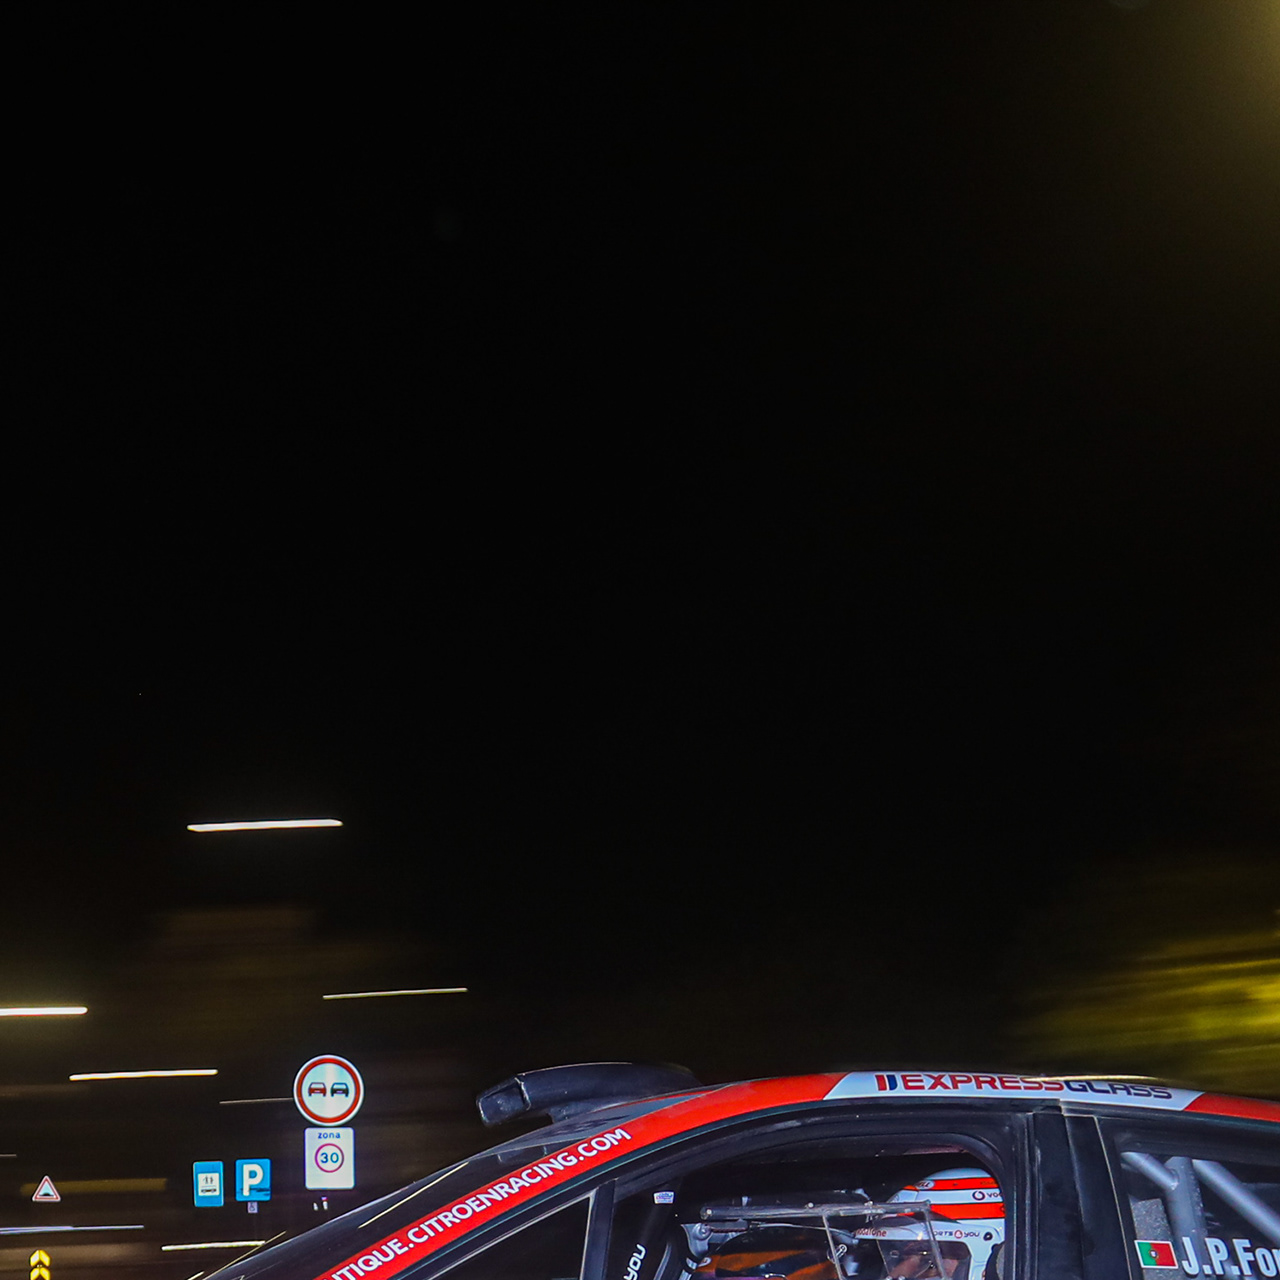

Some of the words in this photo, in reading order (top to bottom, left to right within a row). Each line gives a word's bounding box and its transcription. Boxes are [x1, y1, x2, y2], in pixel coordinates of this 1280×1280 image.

[317, 1131, 341, 1140] zona
[320, 1152, 340, 1164] 30
[242, 1163, 264, 1197] P
